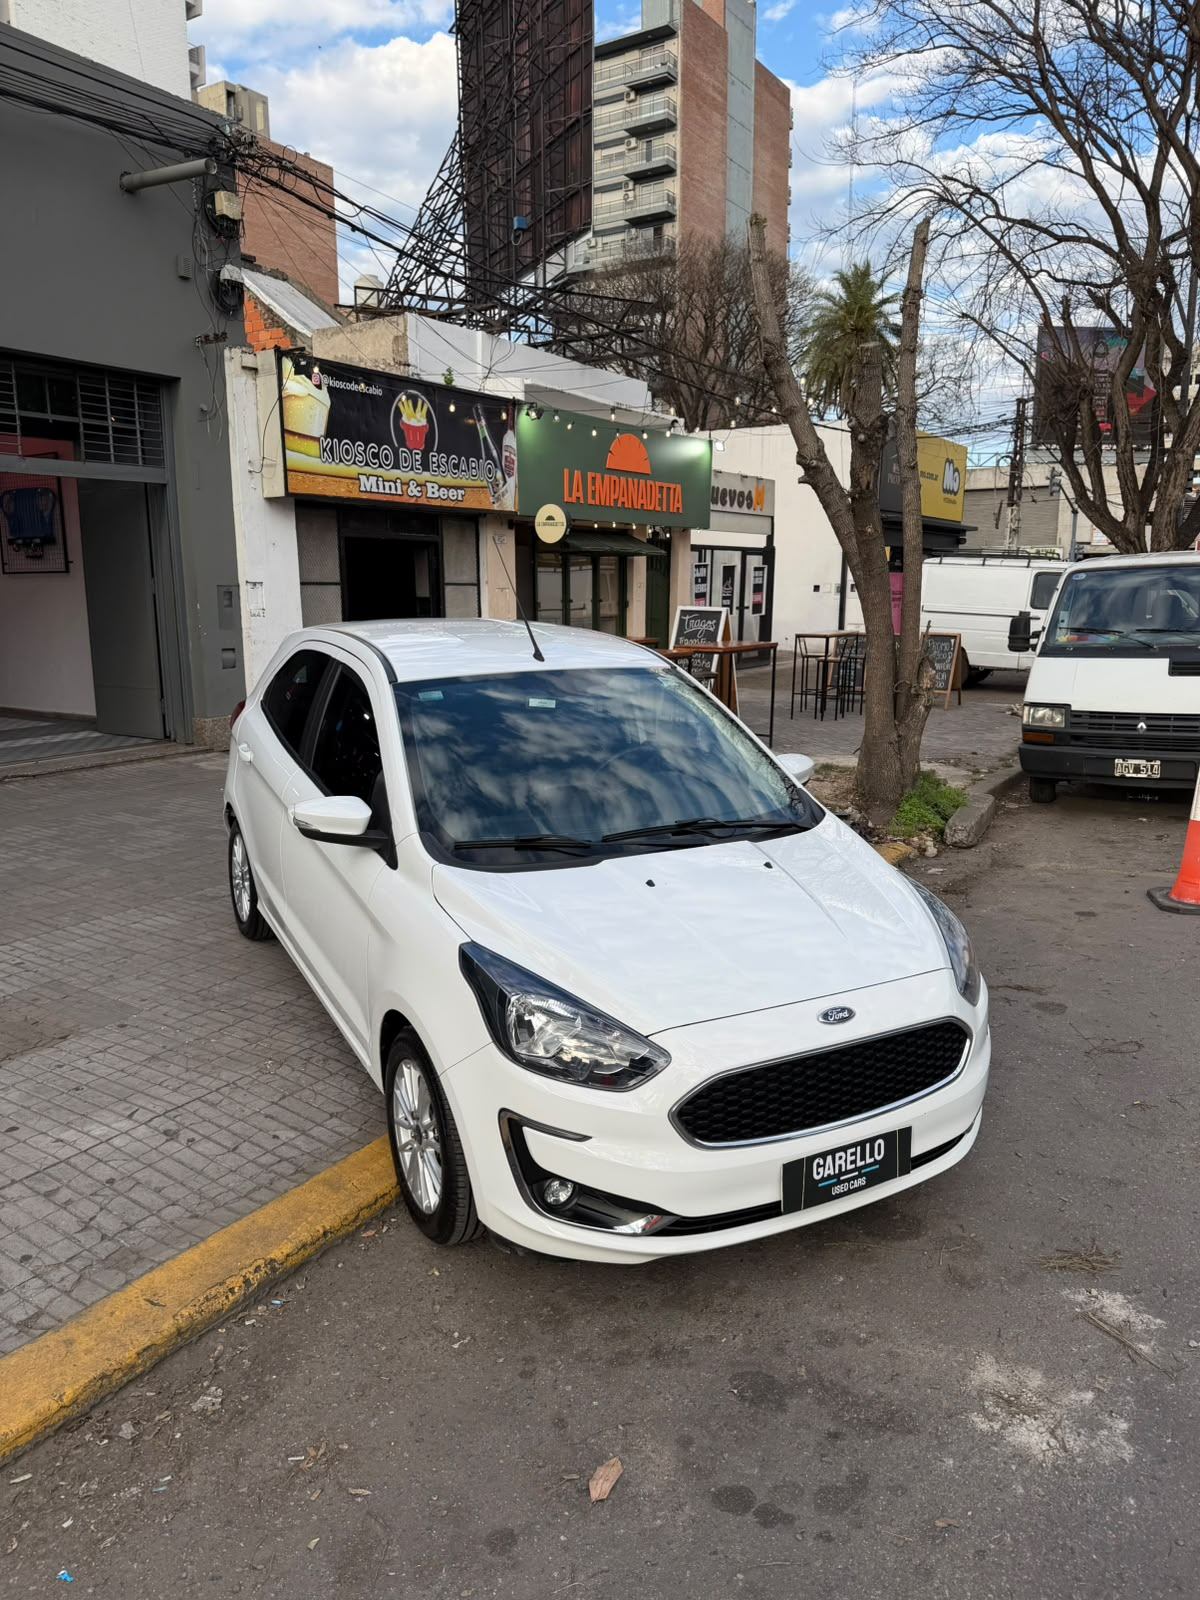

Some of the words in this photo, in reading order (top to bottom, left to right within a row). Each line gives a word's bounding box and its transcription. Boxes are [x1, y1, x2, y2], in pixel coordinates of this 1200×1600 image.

[319, 436, 394, 470] KIOSCO
[399, 447, 423, 473] DE
[429, 452, 496, 482] ESCABIO
[358, 473, 402, 496] Mini
[407, 479, 422, 497] &
[426, 481, 465, 502] Beer
[563, 468, 584, 504] LA
[587, 471, 683, 514] EMPANADETTA
[1117, 763, 1135, 775] AGV
[1140, 764, 1158, 776] 514
[827, 1008, 850, 1021] Ford
[812, 1138, 885, 1181] GARELLO
[831, 1181, 849, 1196] USED
[849, 1176, 867, 1191] CARS
